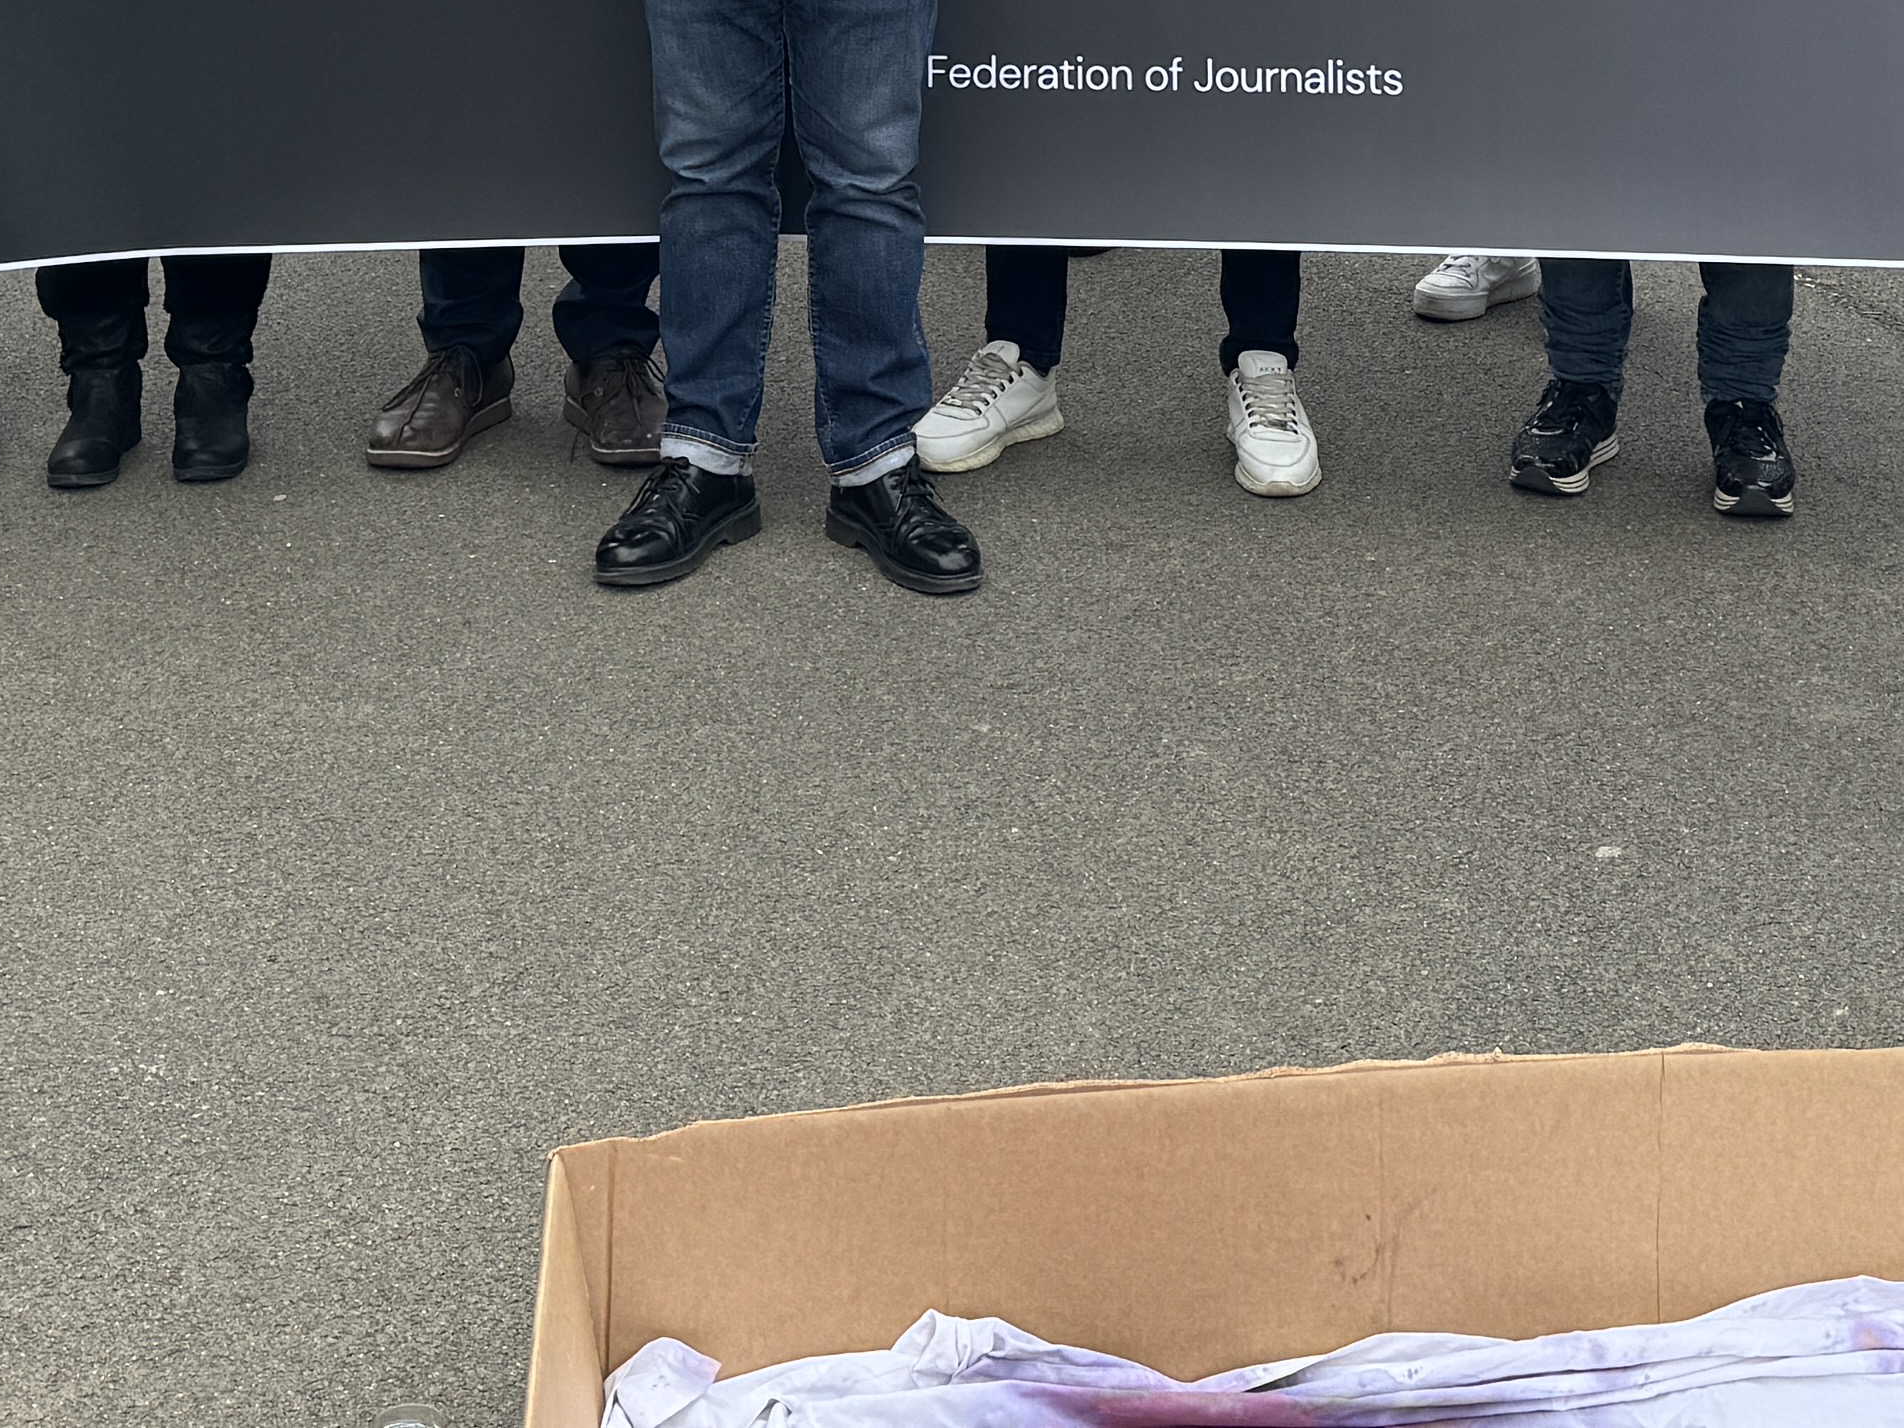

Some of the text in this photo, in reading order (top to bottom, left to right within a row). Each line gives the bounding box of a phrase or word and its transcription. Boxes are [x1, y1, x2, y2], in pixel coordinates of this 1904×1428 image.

[925, 53, 1404, 97] Federation of Journalists
